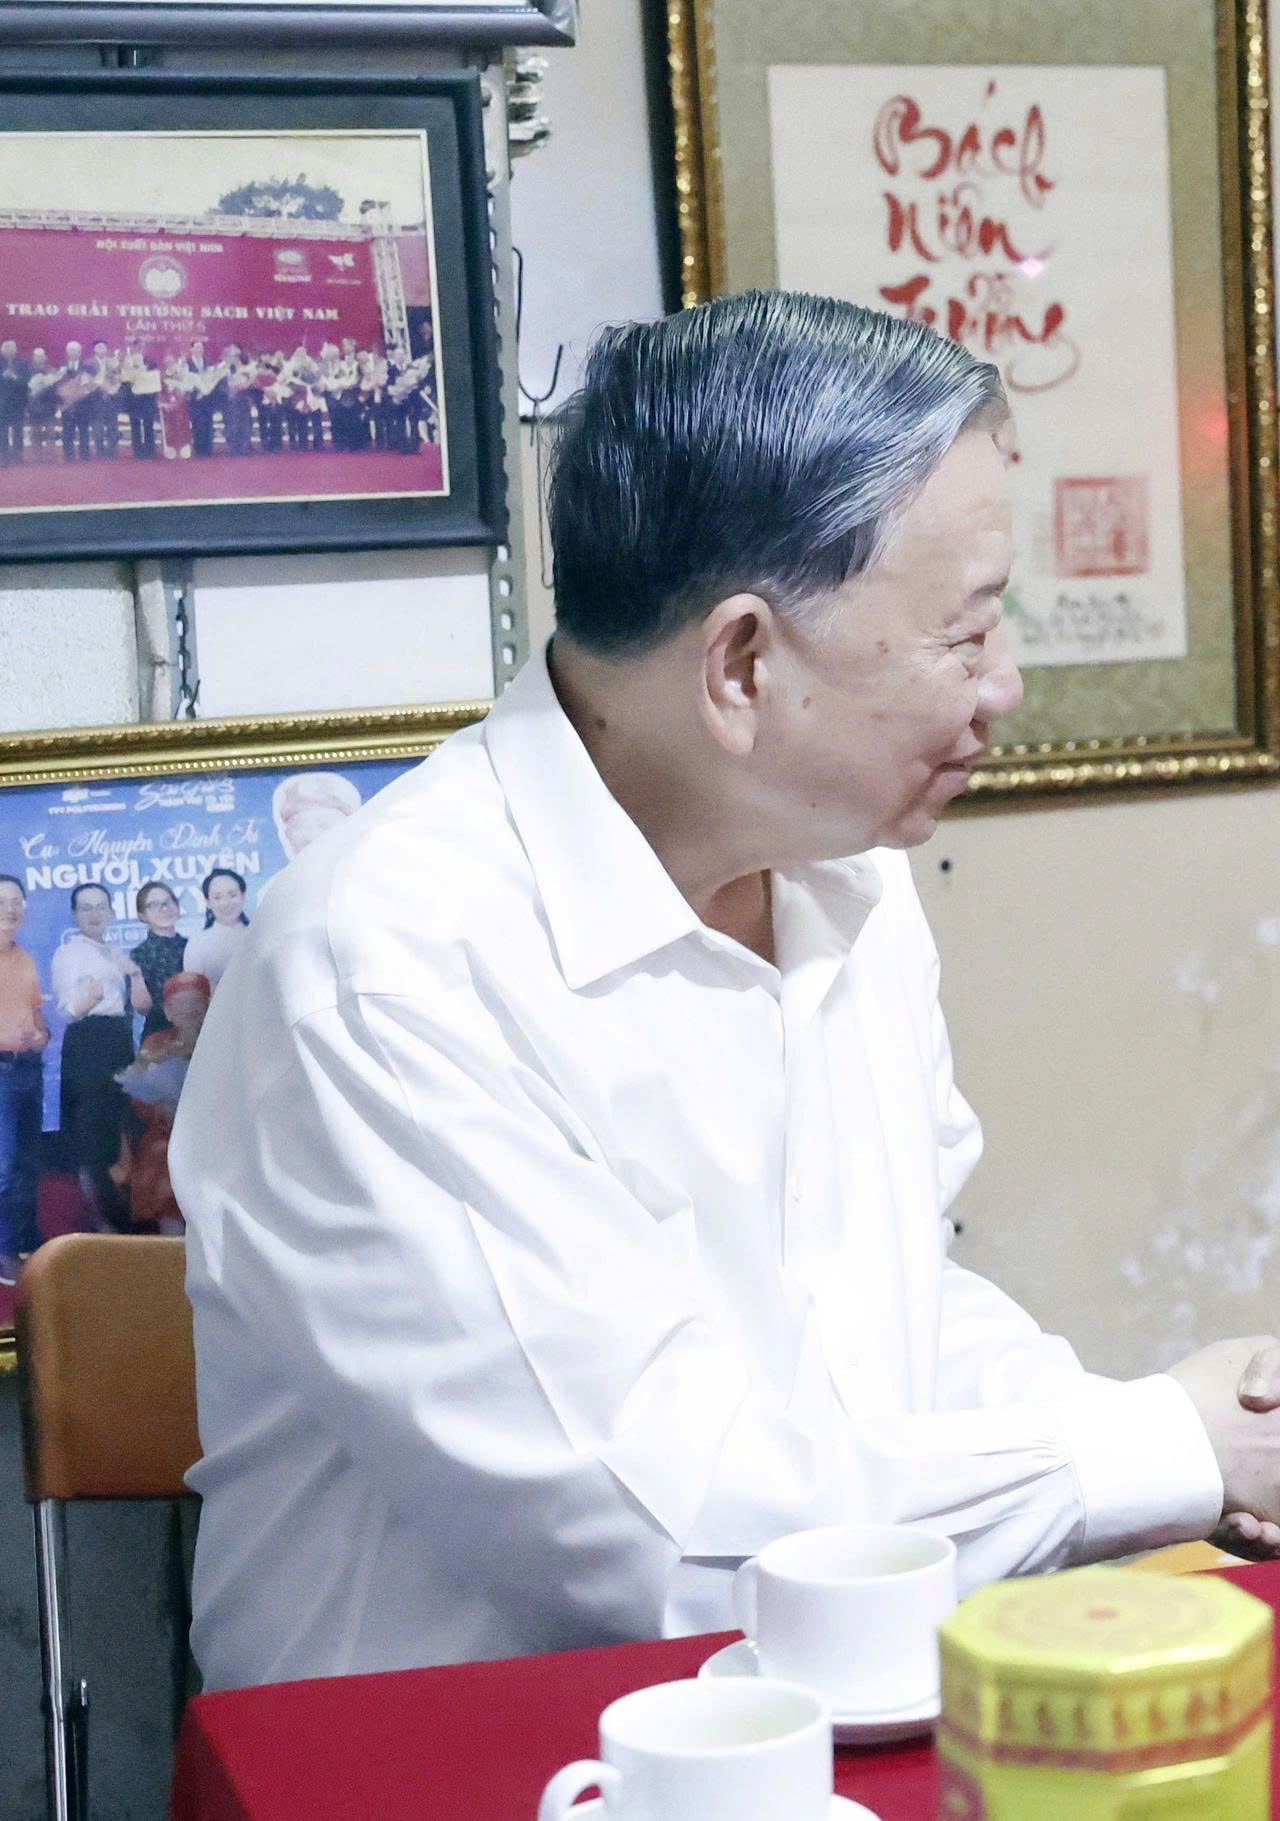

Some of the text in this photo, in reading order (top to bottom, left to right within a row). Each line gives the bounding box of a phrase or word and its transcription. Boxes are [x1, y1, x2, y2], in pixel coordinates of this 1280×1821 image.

[6, 303, 59, 316] TRAO
[201, 303, 248, 319] SÁCH
[256, 306, 295, 321] VIỆT
[303, 308, 339, 320] NAM
[151, 847, 261, 881] XUYÊN
